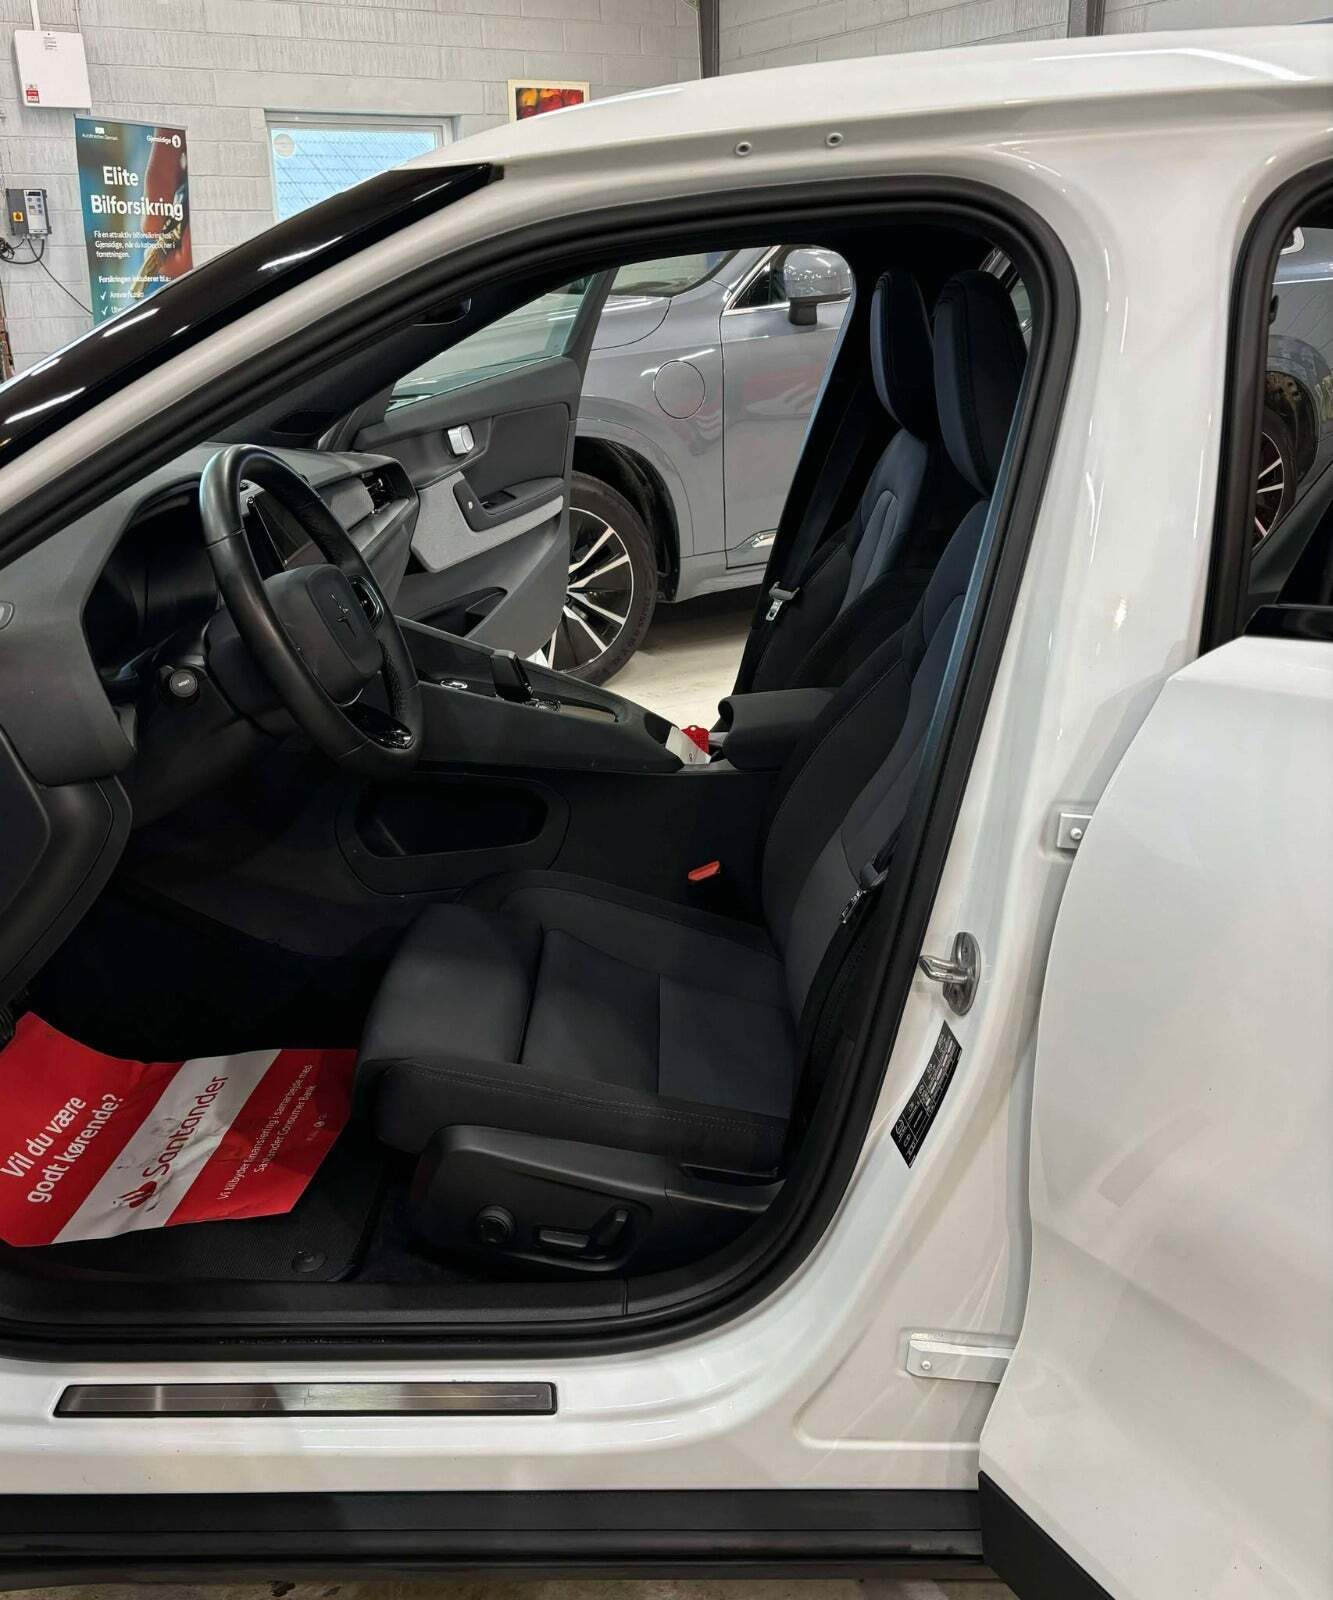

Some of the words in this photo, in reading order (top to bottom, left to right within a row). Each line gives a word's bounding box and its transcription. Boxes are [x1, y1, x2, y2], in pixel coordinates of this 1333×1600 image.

[102, 165, 139, 187] Elite
[90, 194, 184, 220] Bilforsikring
[0, 1151, 35, 1179] Vil
[25, 1132, 55, 1157] du
[46, 1096, 87, 1135] være
[27, 1161, 70, 1204] godt
[54, 1093, 124, 1164] kørende?
[142, 1076, 229, 1177] Santander
[216, 1189, 231, 1200] Vi
[224, 1160, 250, 1191] tilbyder
